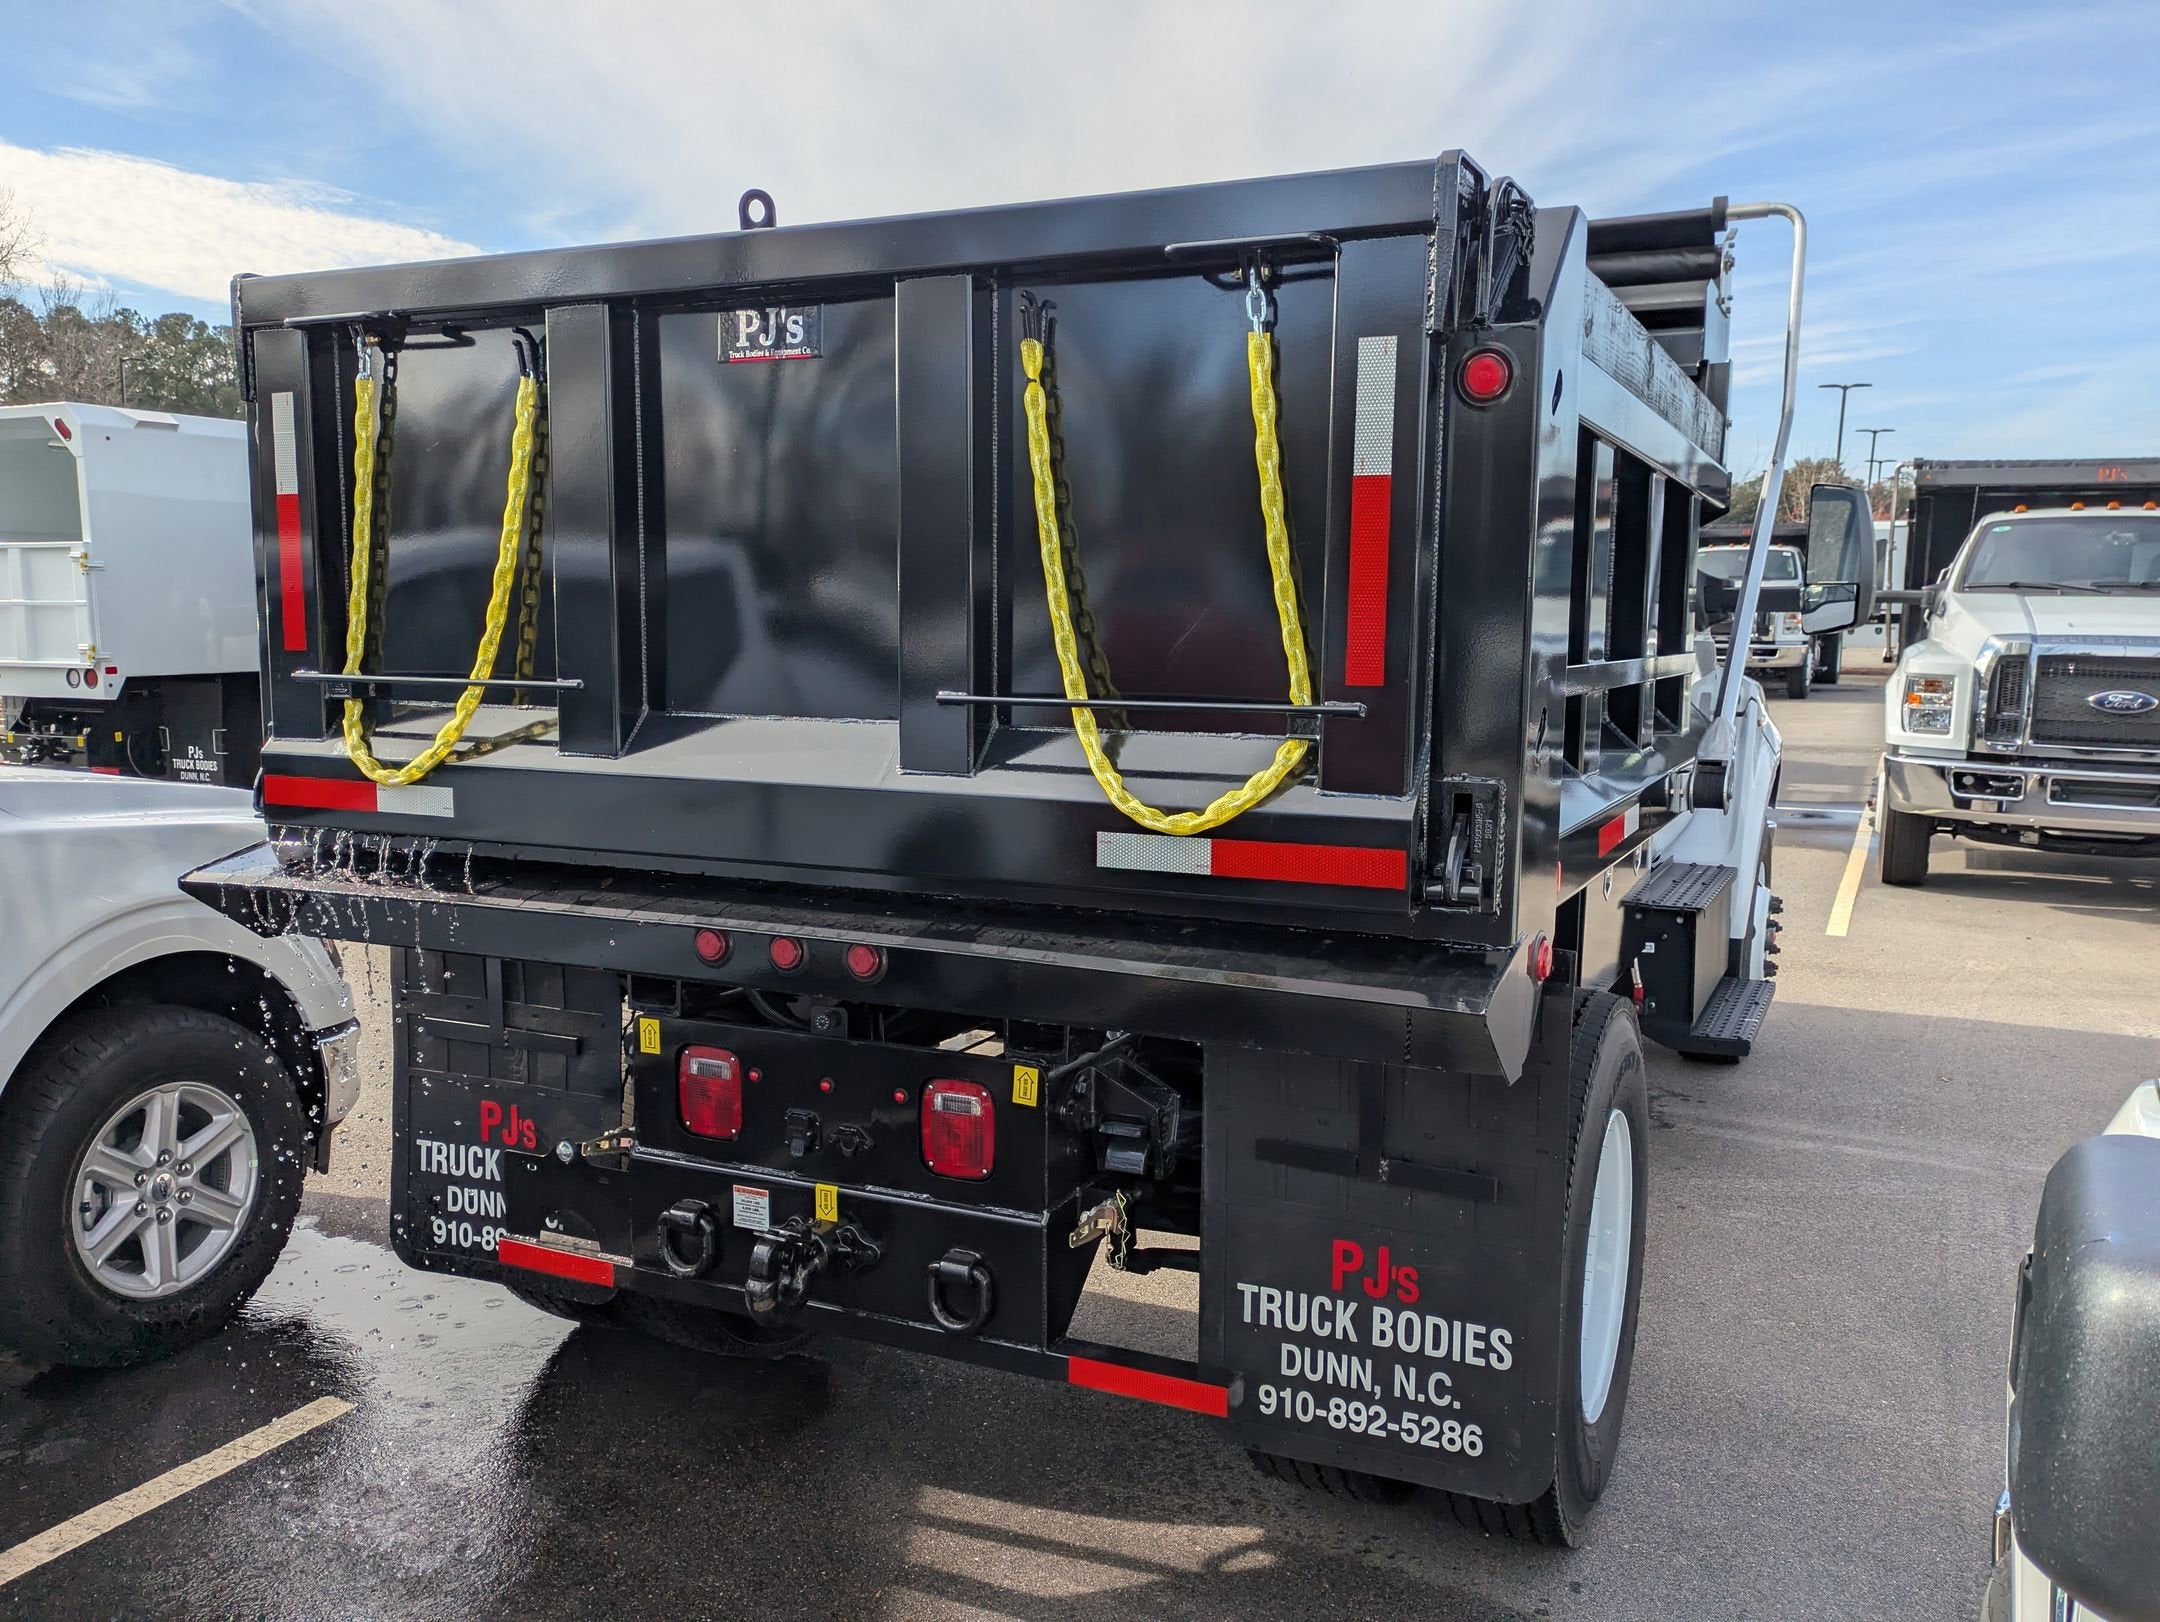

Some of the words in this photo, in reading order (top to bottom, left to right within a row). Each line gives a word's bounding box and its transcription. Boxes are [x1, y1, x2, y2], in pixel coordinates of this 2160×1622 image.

[736, 305, 804, 347] PJ's
[729, 351, 744, 359] Truck
[745, 349, 764, 358] Bodies
[765, 348, 770, 356] &
[2104, 693, 2143, 709] Ford
[172, 758, 195, 770] TRUCK
[195, 759, 218, 771] BODIES
[180, 771, 199, 782] DUNN,
[480, 1100, 537, 1149] PJ's
[416, 1138, 501, 1181] TRUCK
[1331, 1239, 1420, 1303] PJ's
[1237, 1282, 1358, 1342] TRUCK
[1372, 1305, 1513, 1371] BODIES
[1280, 1342, 1382, 1400] DUNN,
[1393, 1364, 1461, 1409] N.C.
[1258, 1384, 1483, 1457] 910-892-5286
